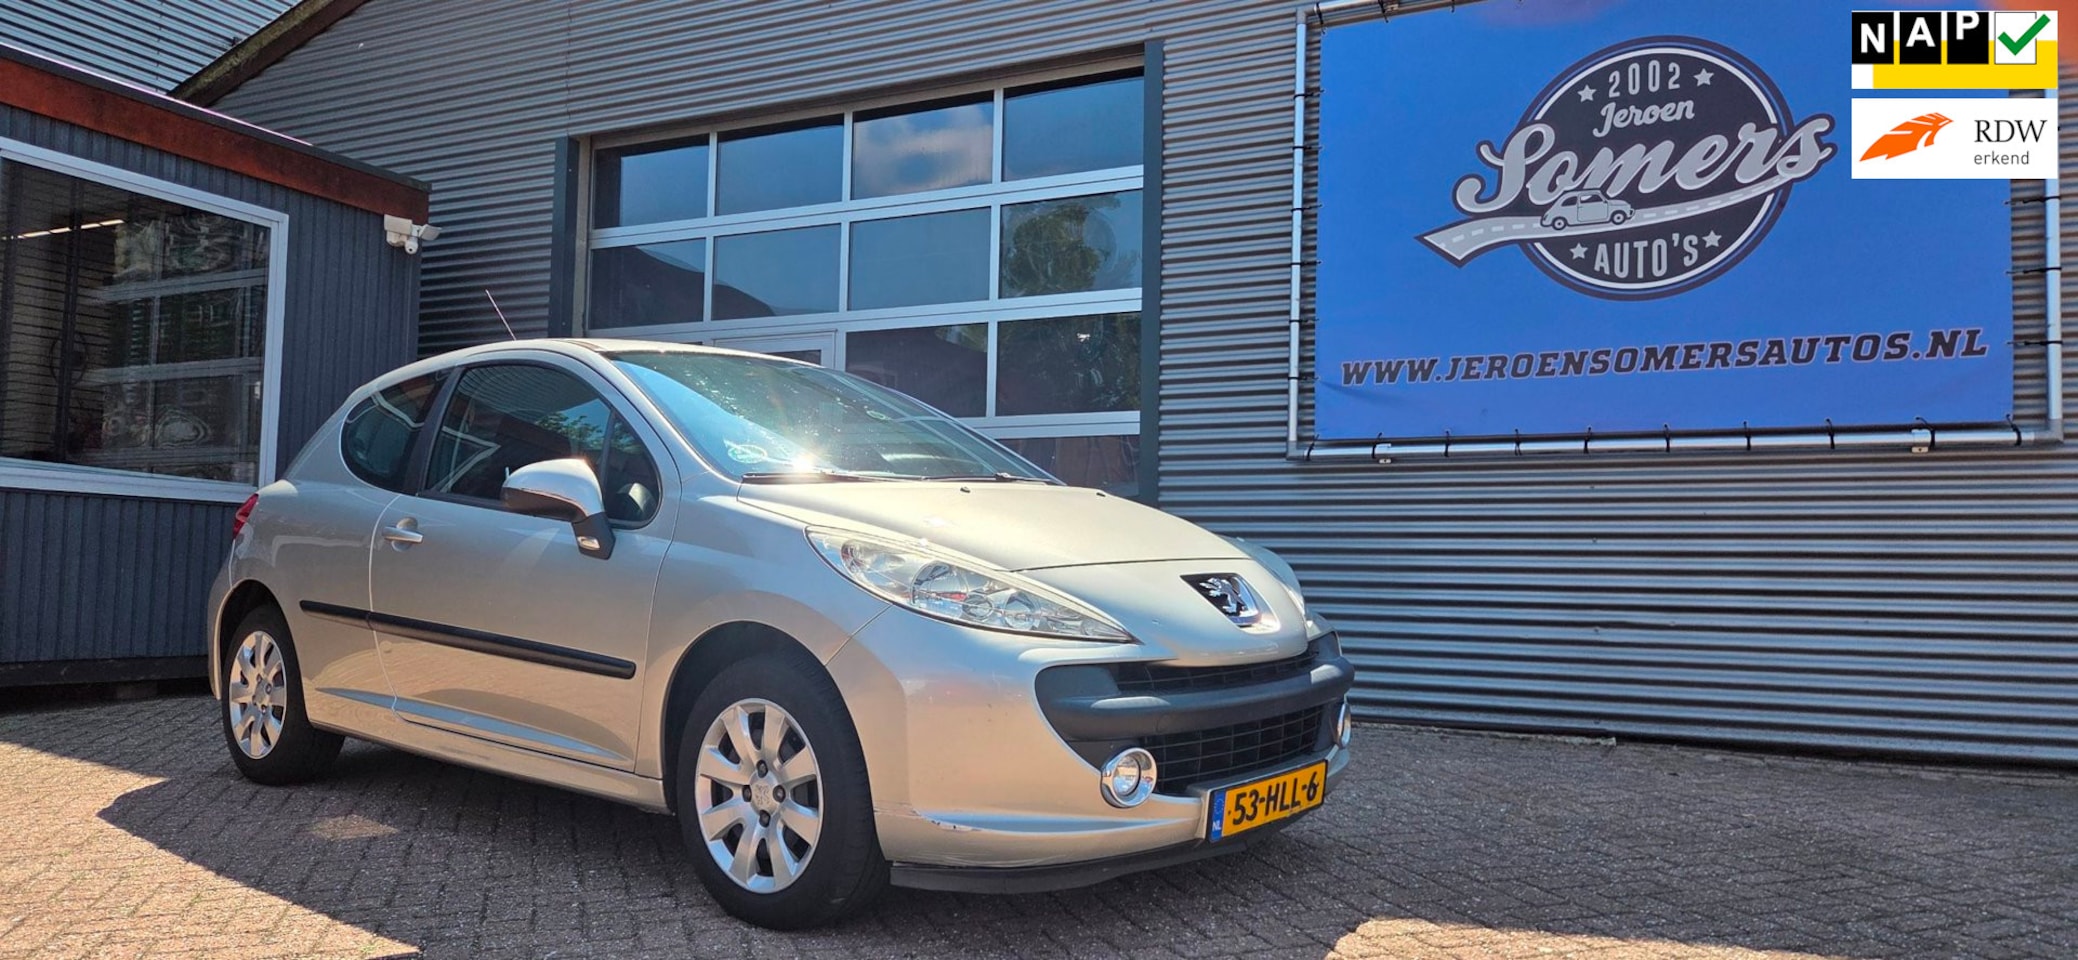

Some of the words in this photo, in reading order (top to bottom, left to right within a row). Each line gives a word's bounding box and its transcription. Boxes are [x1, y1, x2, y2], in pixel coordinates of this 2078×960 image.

[1608, 60, 1681, 98] 2002
[1593, 99, 1695, 138] Jeroen
[1455, 117, 1831, 213] Somers
[1594, 232, 1698, 279] AUTO'S
[1341, 327, 1989, 386] WWW.JEROENSOMERSAUTOS.NL
[1232, 771, 1320, 826] 53-HLL-6
[1211, 819, 1222, 832] NL
